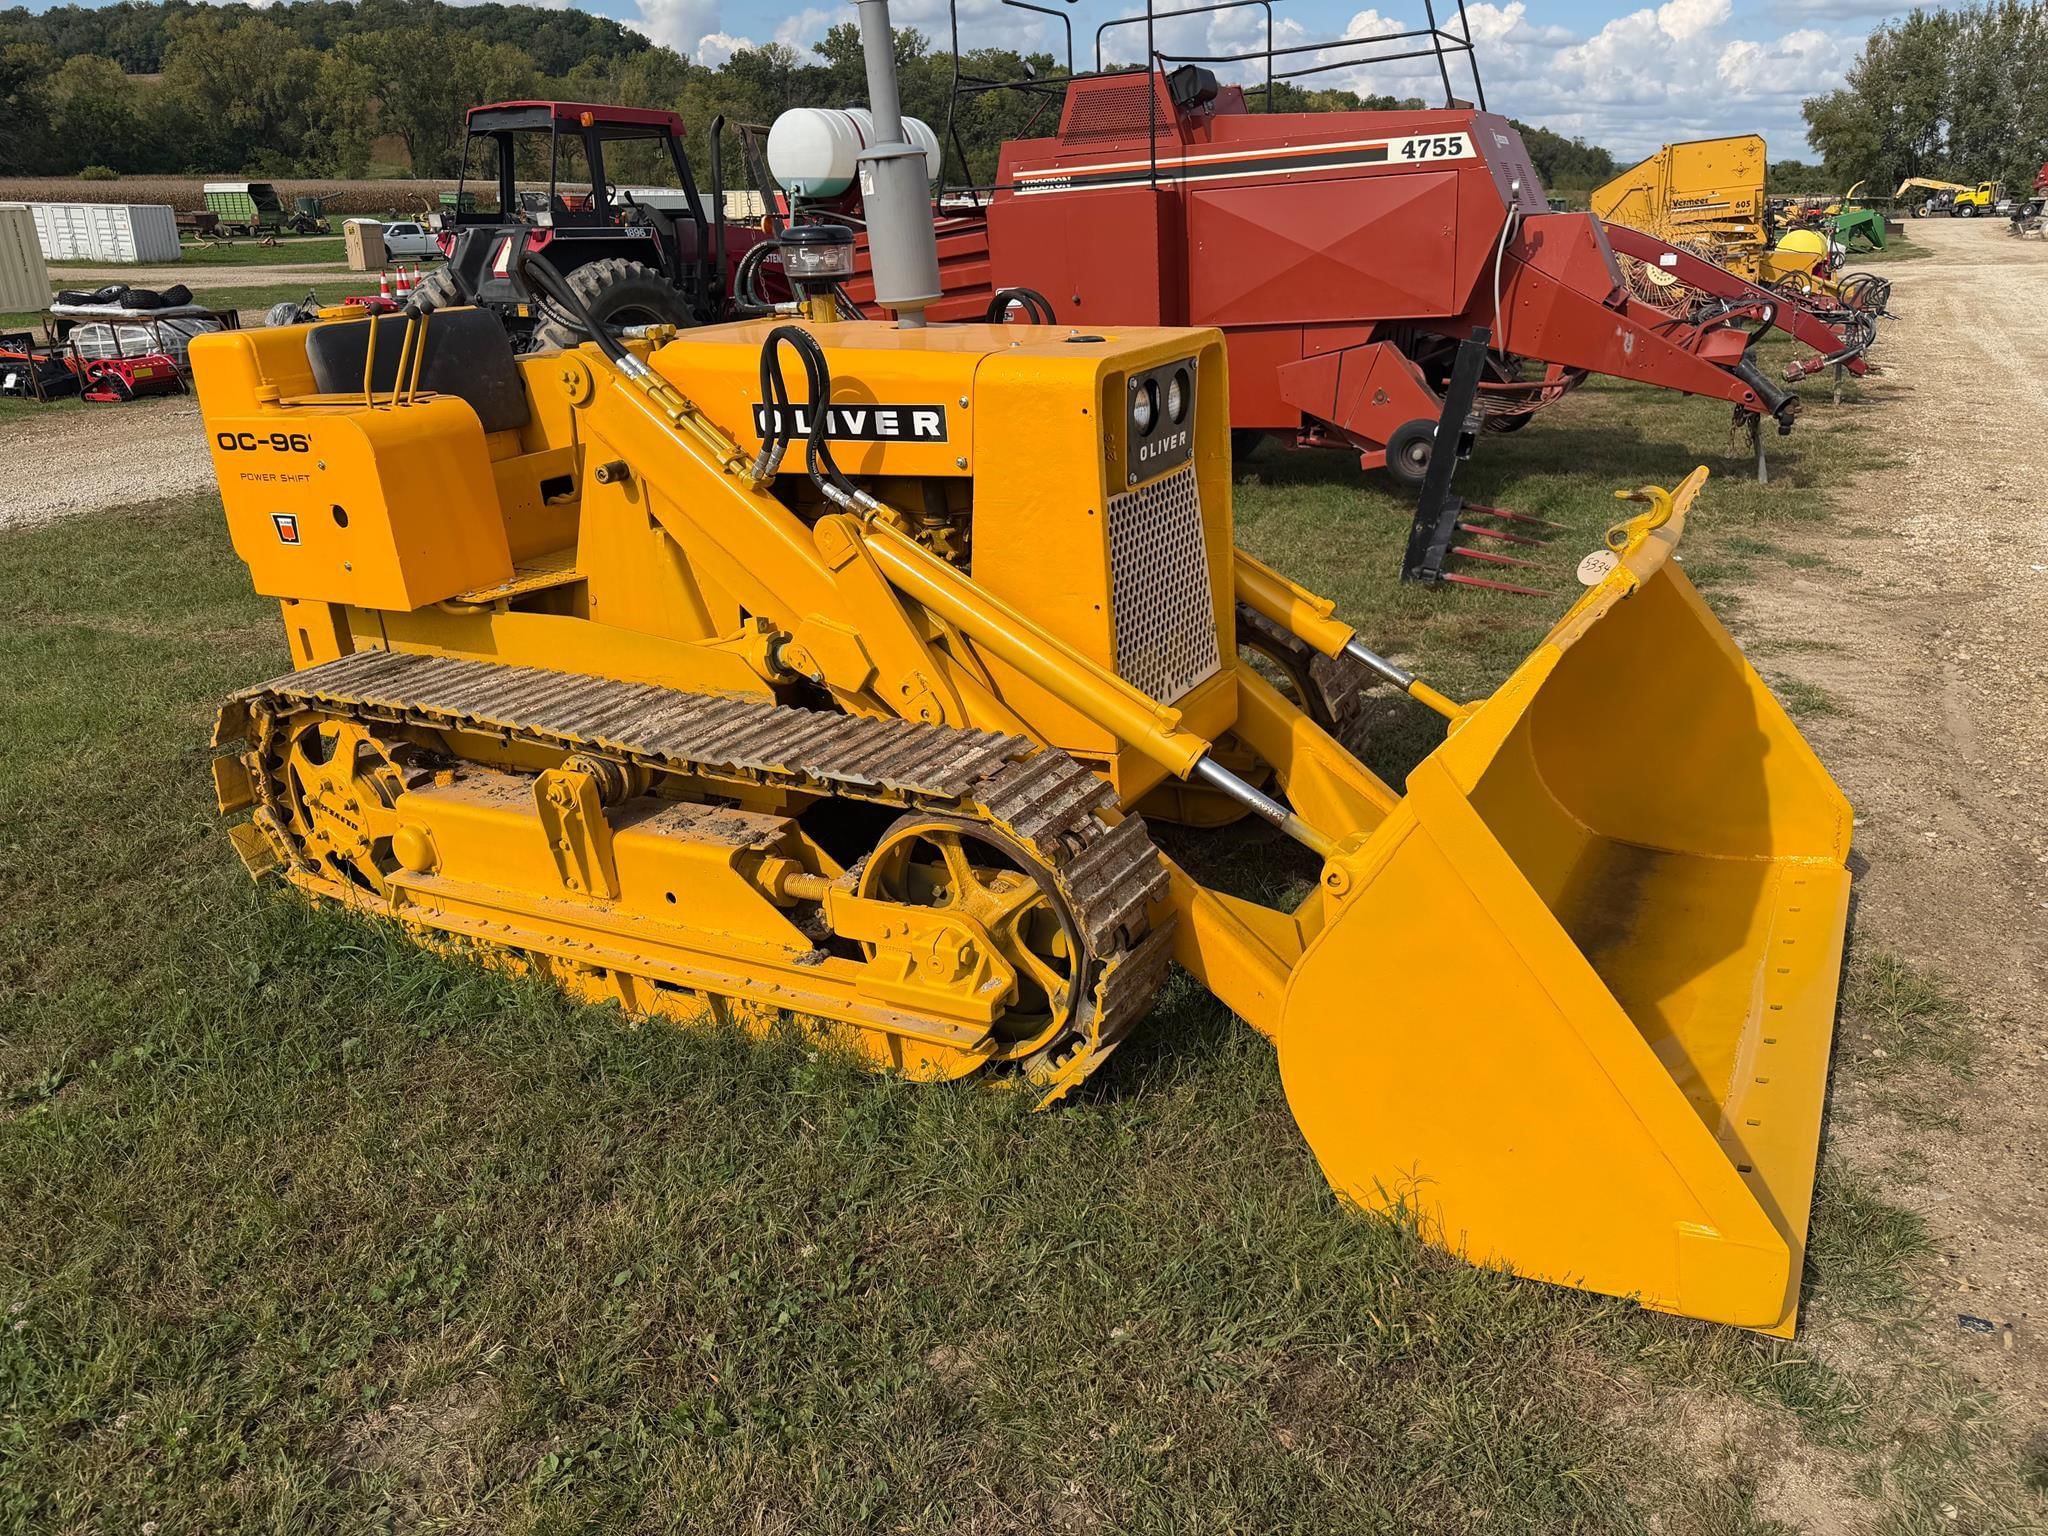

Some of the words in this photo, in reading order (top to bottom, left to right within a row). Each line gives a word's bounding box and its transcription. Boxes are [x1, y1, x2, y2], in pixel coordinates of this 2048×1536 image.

[1402, 137, 1462, 159] 4755
[1672, 198, 1709, 207] Vermeer
[1735, 200, 1751, 208] 605
[625, 228, 646, 238] 1896
[759, 410, 941, 436] OLIVER
[1140, 431, 1186, 461] OLIVER
[240, 473, 277, 482] POWER
[280, 474, 310, 482] SHIFT
[1581, 557, 1611, 576] 5334
